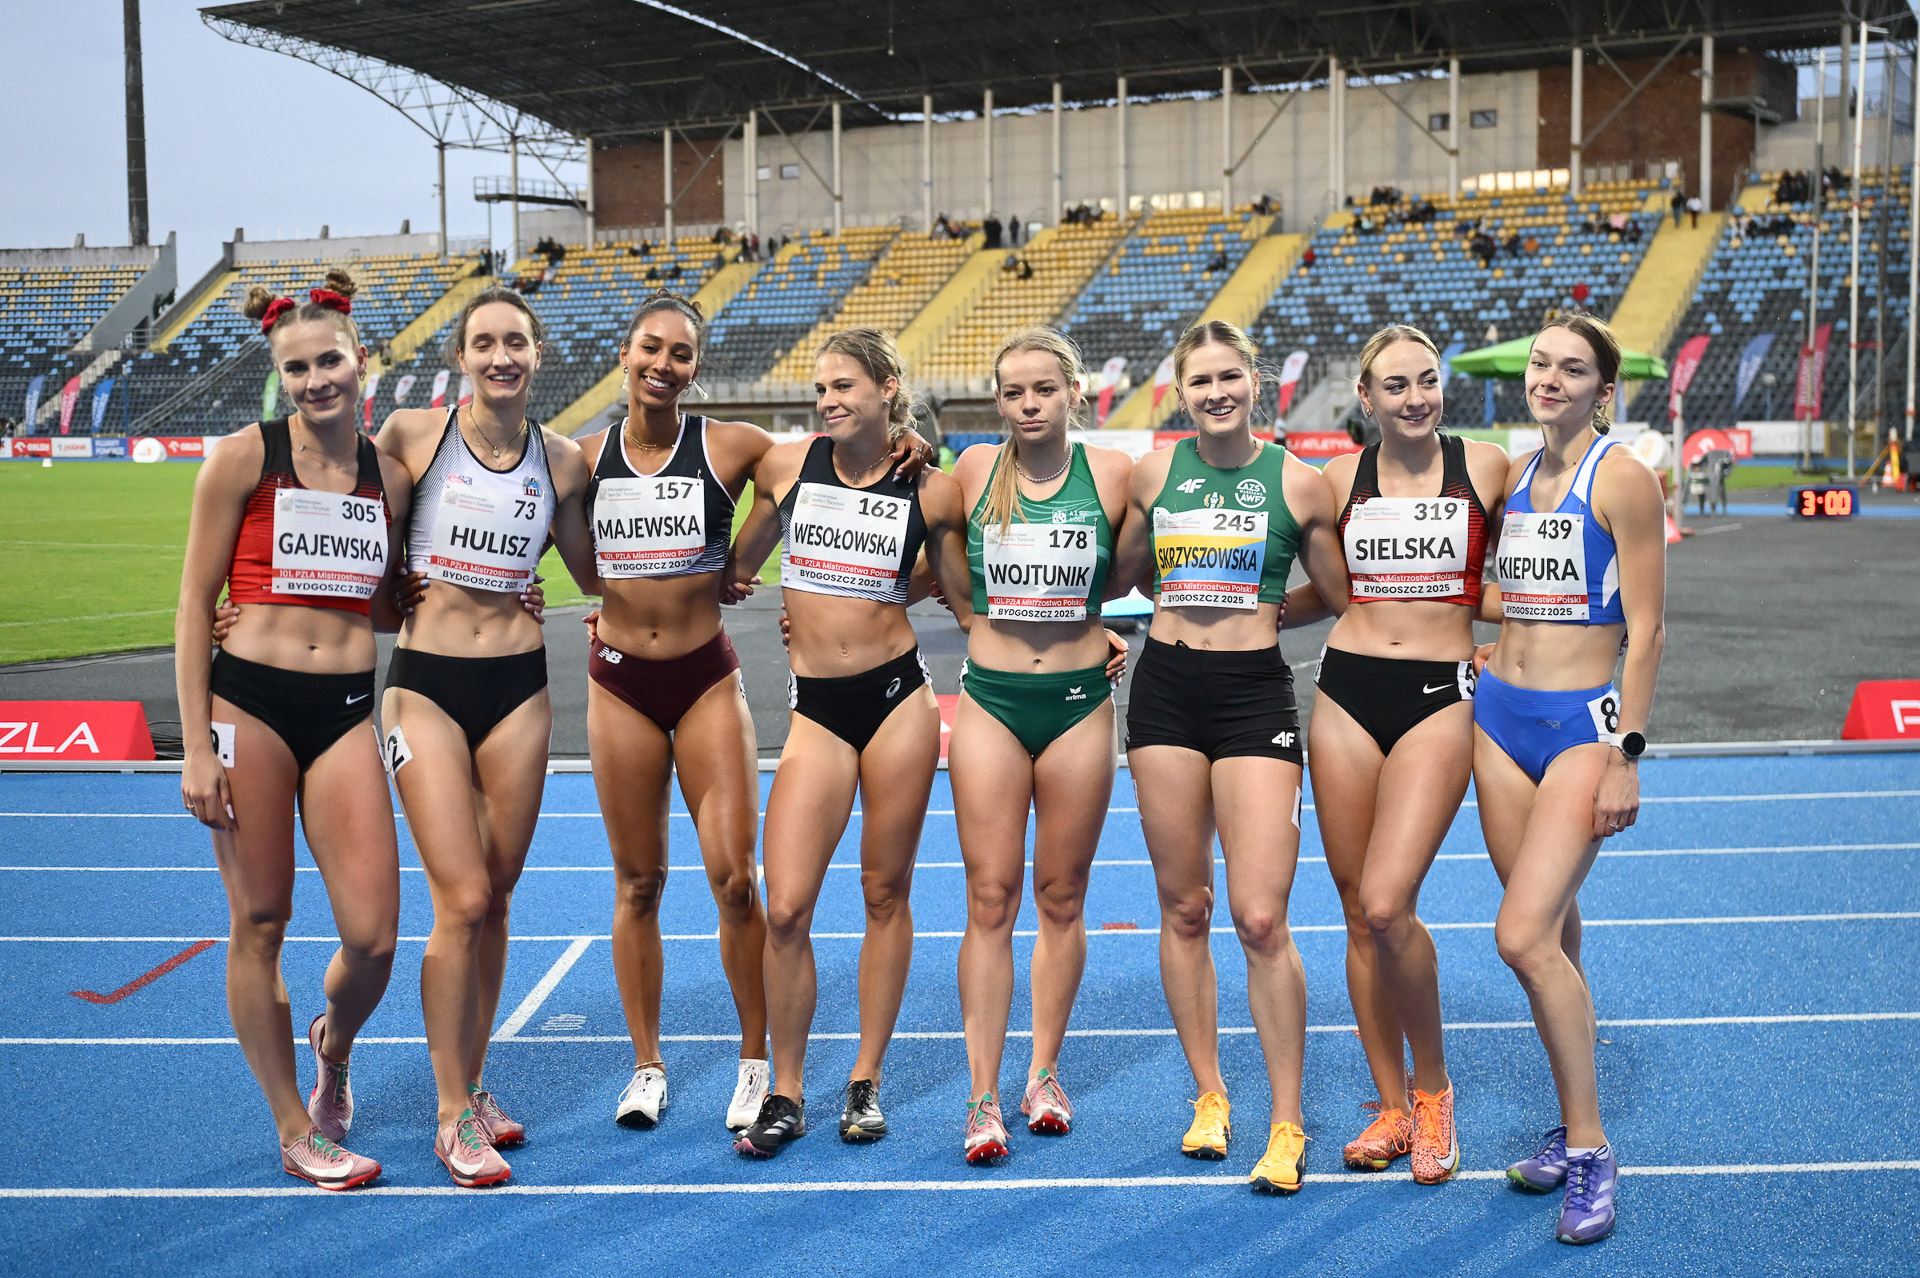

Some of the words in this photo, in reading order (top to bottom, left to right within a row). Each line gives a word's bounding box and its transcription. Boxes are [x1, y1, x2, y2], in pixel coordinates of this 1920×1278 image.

[27, 443, 50, 451] ORLEN
[180, 443, 202, 451] ORLEN
[448, 474, 472, 486] esa
[1176, 479, 1206, 493] 4F
[1243, 482, 1260, 492] AZS
[654, 482, 693, 500] 157
[1241, 494, 1261, 503] AWF
[342, 501, 376, 523] 305
[514, 500, 536, 520] 73
[858, 497, 898, 520] 162
[1414, 502, 1457, 521] 319
[597, 515, 700, 540] MAJEWSKA
[1213, 513, 1256, 531] 245
[1537, 519, 1572, 539] 439
[278, 532, 383, 563] GAJEWSKA
[450, 525, 531, 558] HULISZ
[794, 522, 897, 557] WESOŁOWSKA
[1049, 530, 1088, 550] 178
[632, 551, 676, 559] Mistrzostwa
[678, 548, 700, 556] Polski
[1356, 537, 1456, 561] SIELSKA
[437, 557, 449, 566] 101.
[450, 560, 468, 571] PZLA
[470, 563, 514, 578] Mistrzostwa
[613, 562, 666, 570] BYDGOSZCZ
[669, 560, 692, 568] 2025
[794, 557, 804, 566] 101.
[805, 559, 820, 568] PZLA
[822, 561, 869, 575] Mistrzostwa
[870, 568, 892, 578] Polski
[1159, 547, 1257, 571] SKRZYSZOWSKA
[280, 569, 294, 578] 101.
[295, 570, 315, 578] PZLA
[317, 570, 362, 582] Mistrzostwa
[988, 564, 1090, 587] WOJTUNIK
[1498, 556, 1580, 581] KIEPURA
[443, 570, 503, 588] BYDGOSZCZ
[800, 570, 856, 584] BYDGOSZCZ
[858, 578, 881, 587] 2025
[1387, 574, 1435, 582] Mistrzostwa
[288, 582, 353, 593] BYDGOSZCZ
[355, 586, 372, 596] 2025
[1183, 583, 1230, 591] Mistrzostwa
[1232, 584, 1252, 592] Polski
[1364, 585, 1424, 594] BYDGOSZCZ
[1427, 584, 1450, 593] 2025
[1022, 598, 1062, 606] Mistrzostwa
[1168, 594, 1219, 603] BYDGOSZCZ
[1222, 595, 1244, 604] 2025
[1520, 595, 1555, 603] Mistrzostwa
[1557, 595, 1581, 603] Polski
[998, 608, 1054, 618] BYDGOSZCZ
[1054, 609, 1075, 618] 2025
[1506, 606, 1546, 616] BYDGOSZCZ
[1547, 607, 1572, 616] 2025
[1536, 717, 1561, 730] esa
[1601, 697, 1618, 734] 8
[1272, 731, 1295, 748] 4F
